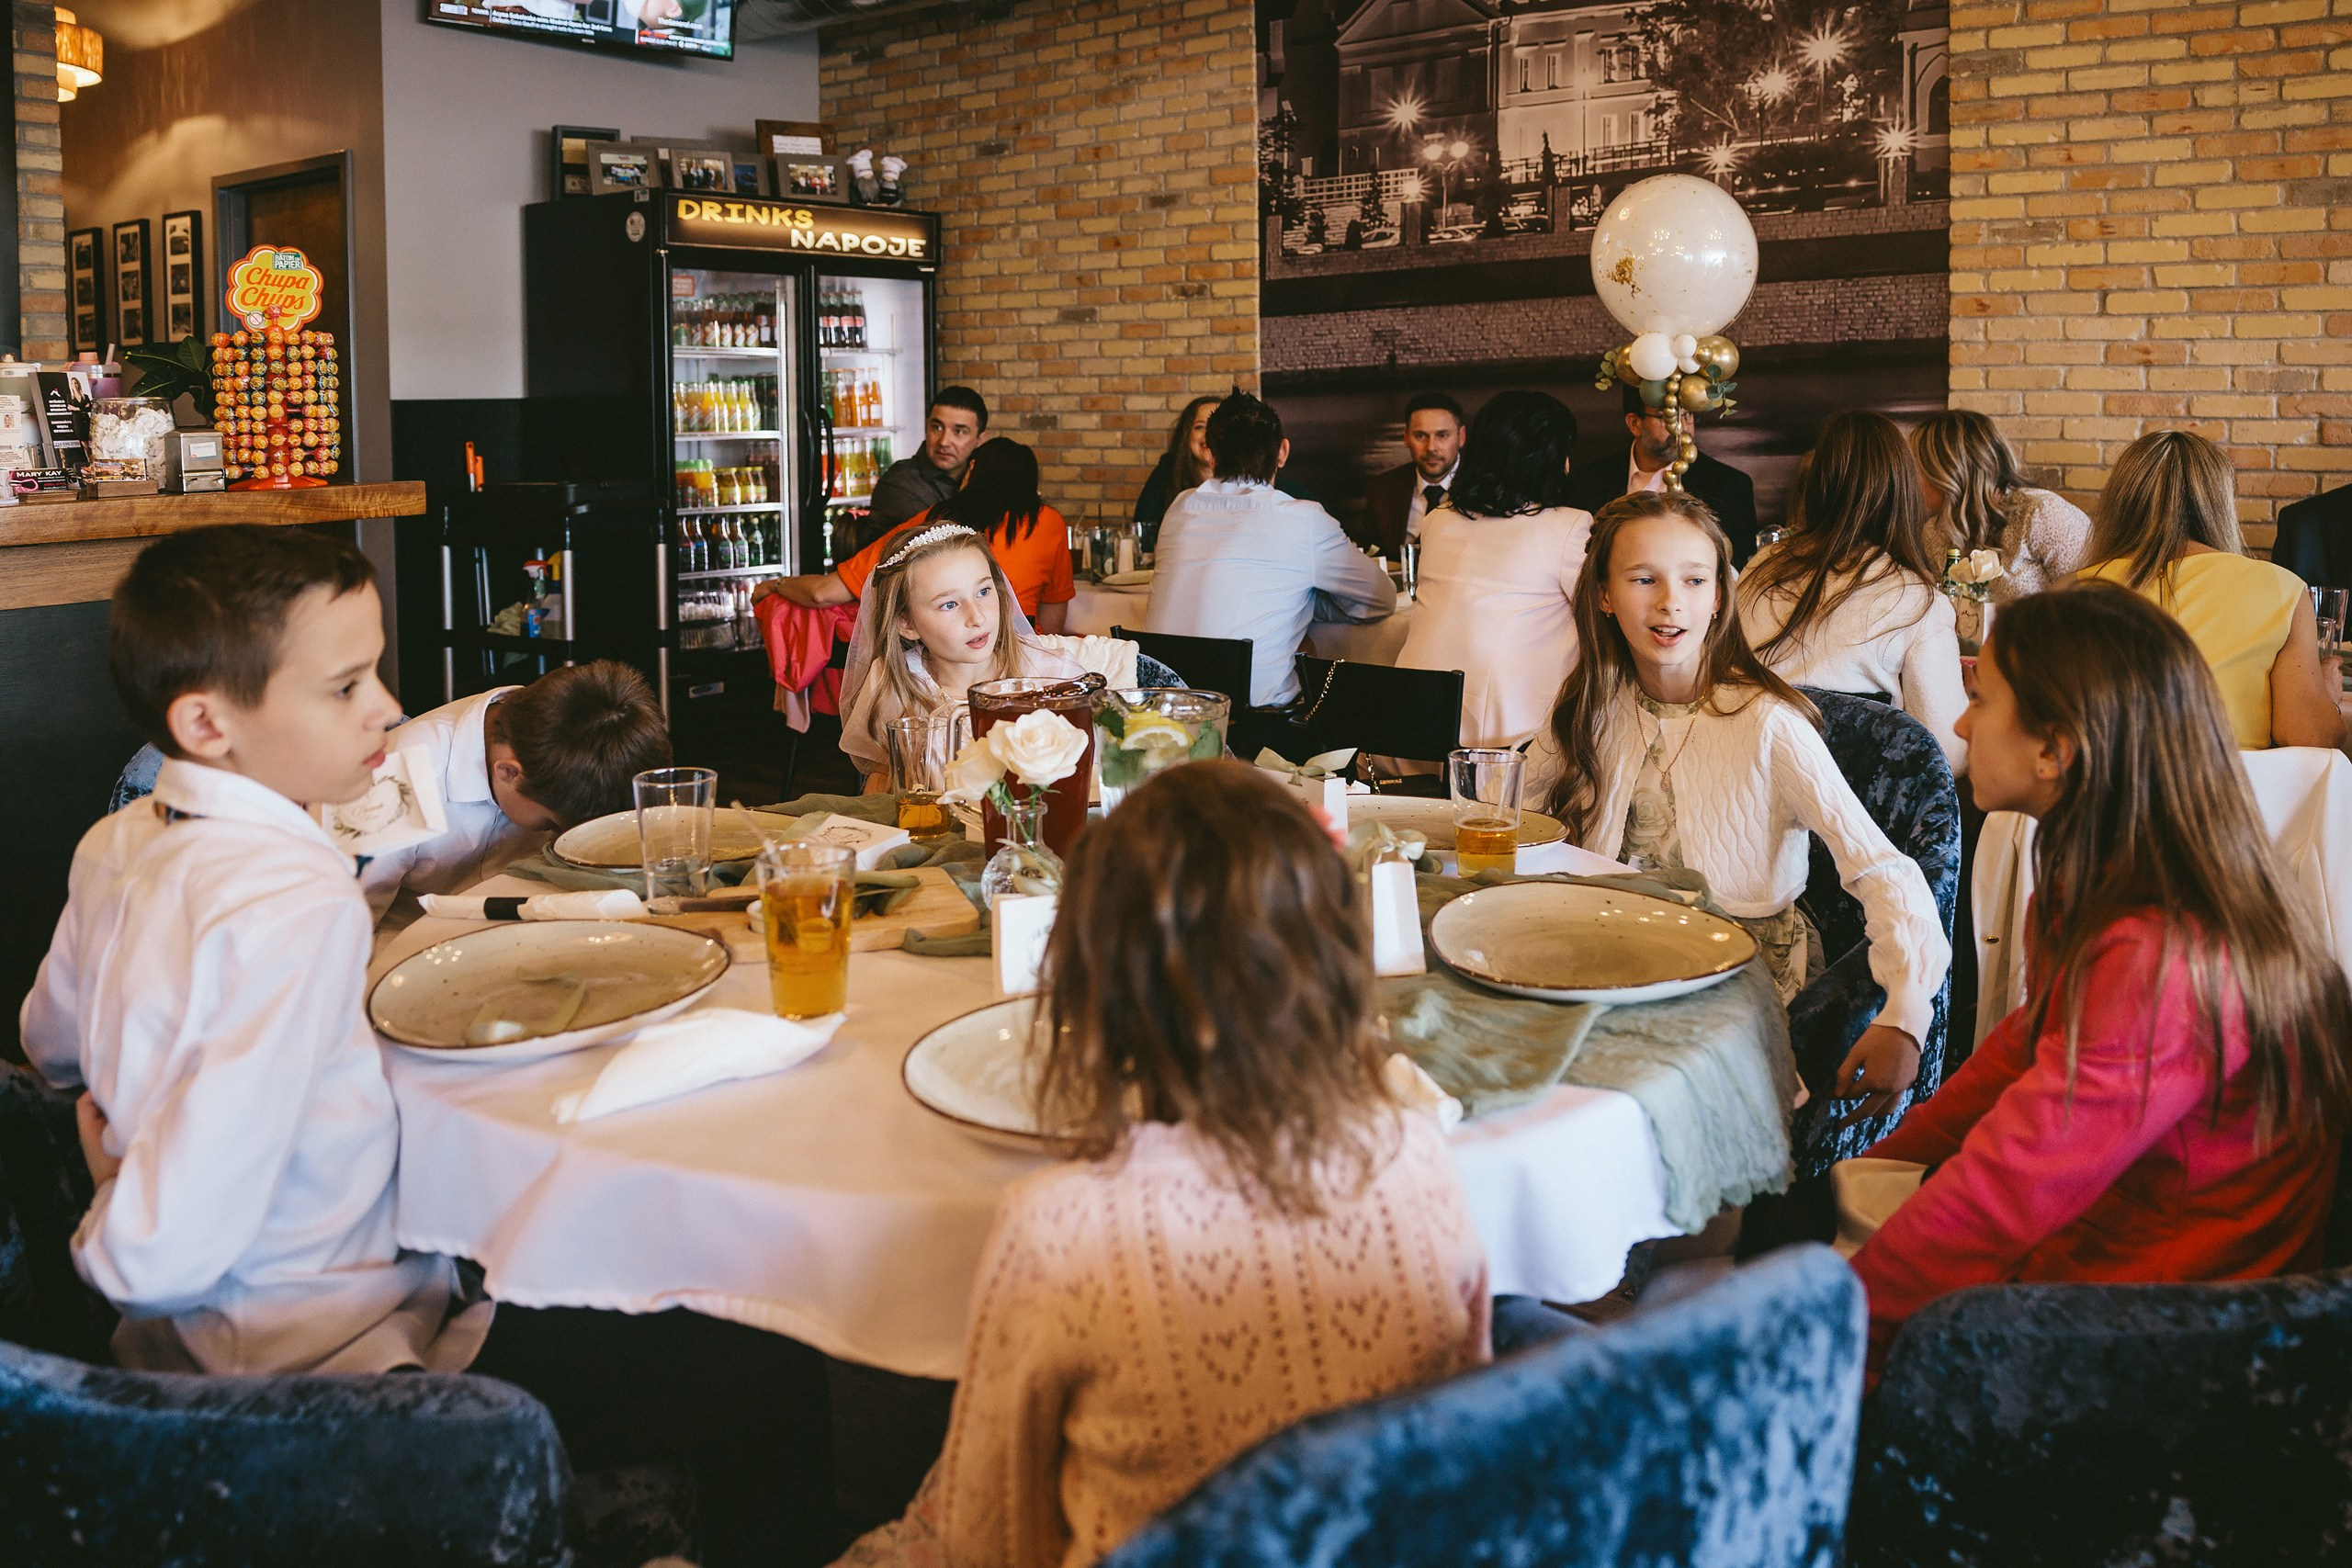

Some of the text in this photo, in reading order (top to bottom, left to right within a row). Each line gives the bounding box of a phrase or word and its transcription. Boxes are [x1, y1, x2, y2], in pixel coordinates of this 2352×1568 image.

[677, 199, 814, 229] DRINKS
[790, 229, 926, 258] NAPOJE
[275, 261, 300, 269] PAPIER
[246, 267, 310, 292] Chupa
[241, 287, 305, 310] Chups
